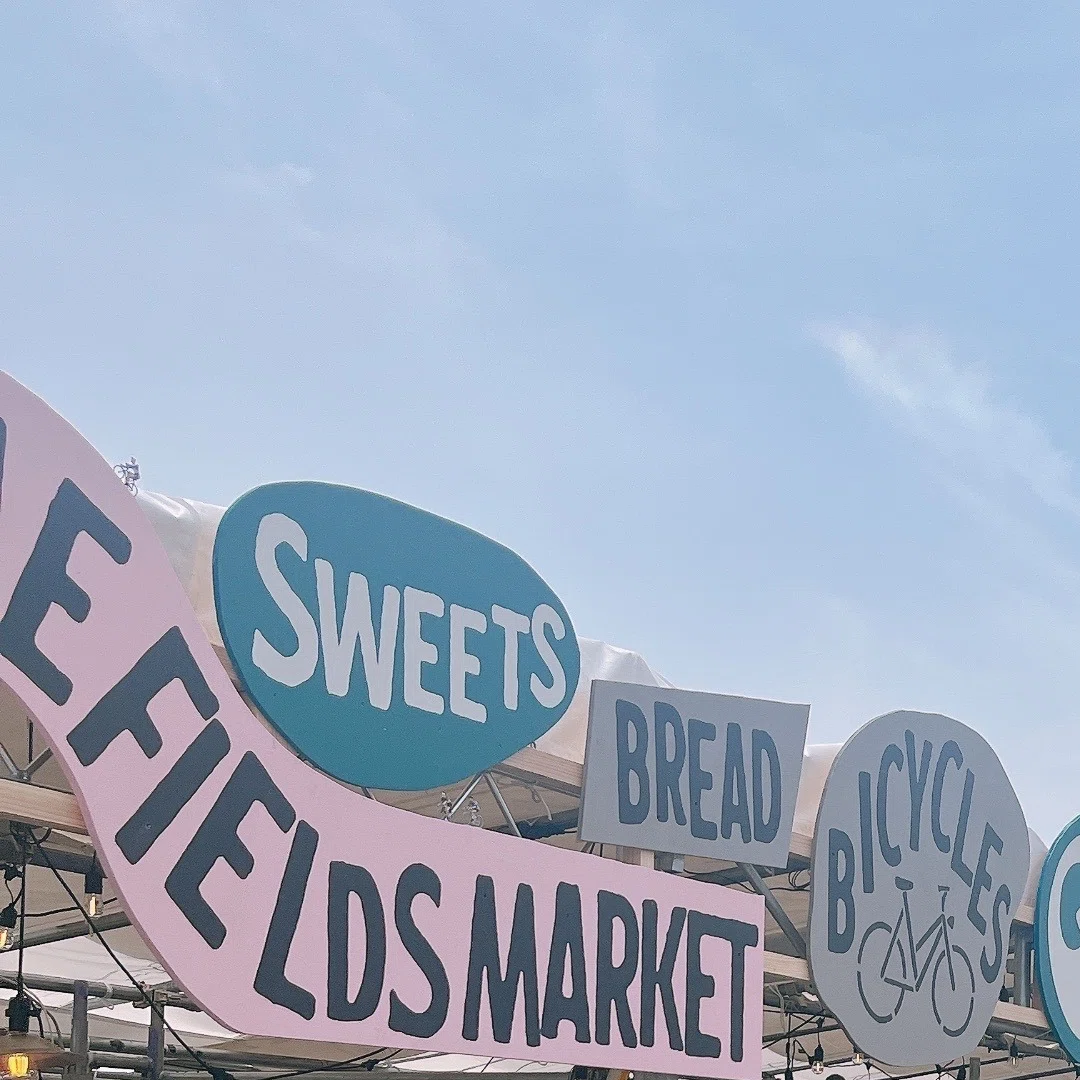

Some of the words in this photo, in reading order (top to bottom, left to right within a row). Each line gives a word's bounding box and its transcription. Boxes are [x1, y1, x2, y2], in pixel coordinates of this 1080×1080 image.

[251, 511, 568, 723] SWEETS
[0, 418, 132, 706] E
[461, 874, 760, 1063] MARKET
[614, 698, 784, 846] BREAD
[827, 728, 1011, 985] BICYCLES
